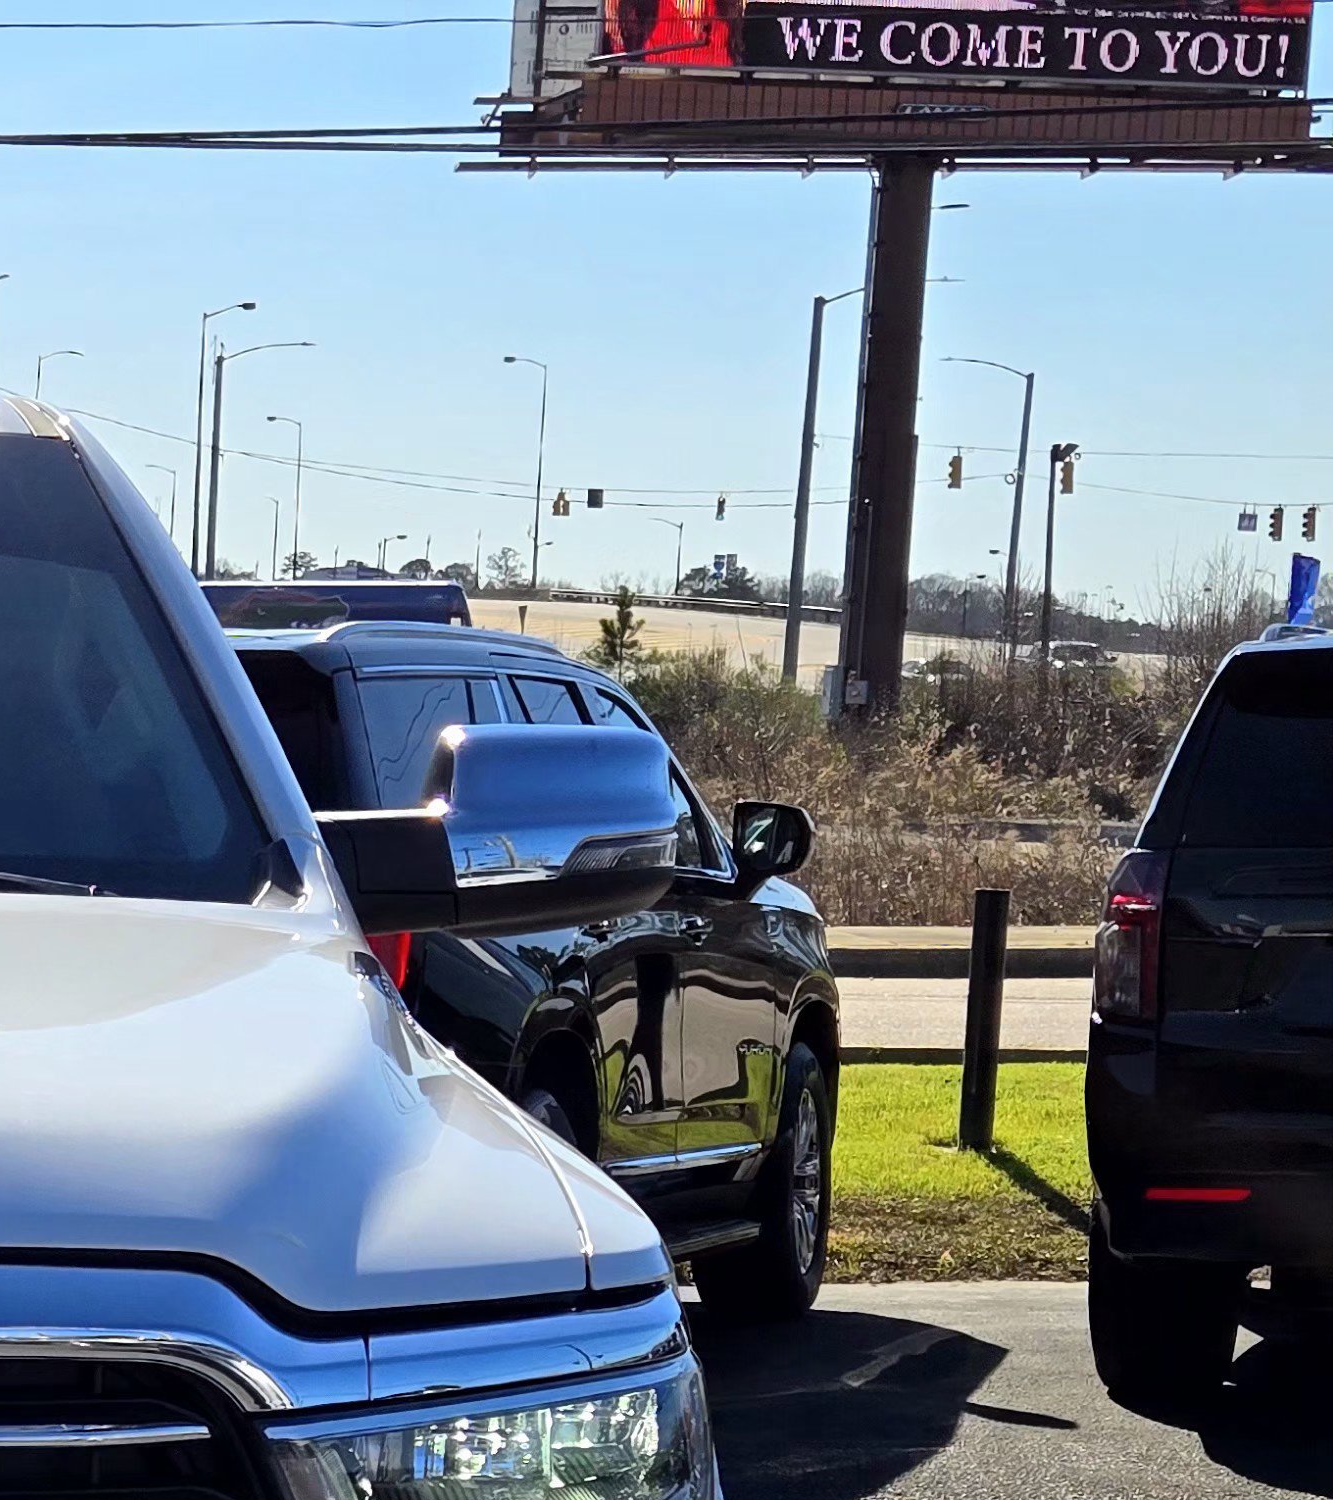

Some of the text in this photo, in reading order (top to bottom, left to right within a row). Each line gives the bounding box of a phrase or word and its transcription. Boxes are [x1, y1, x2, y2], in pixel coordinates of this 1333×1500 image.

[777, 17, 1289, 78] WE COME TO YOU!
